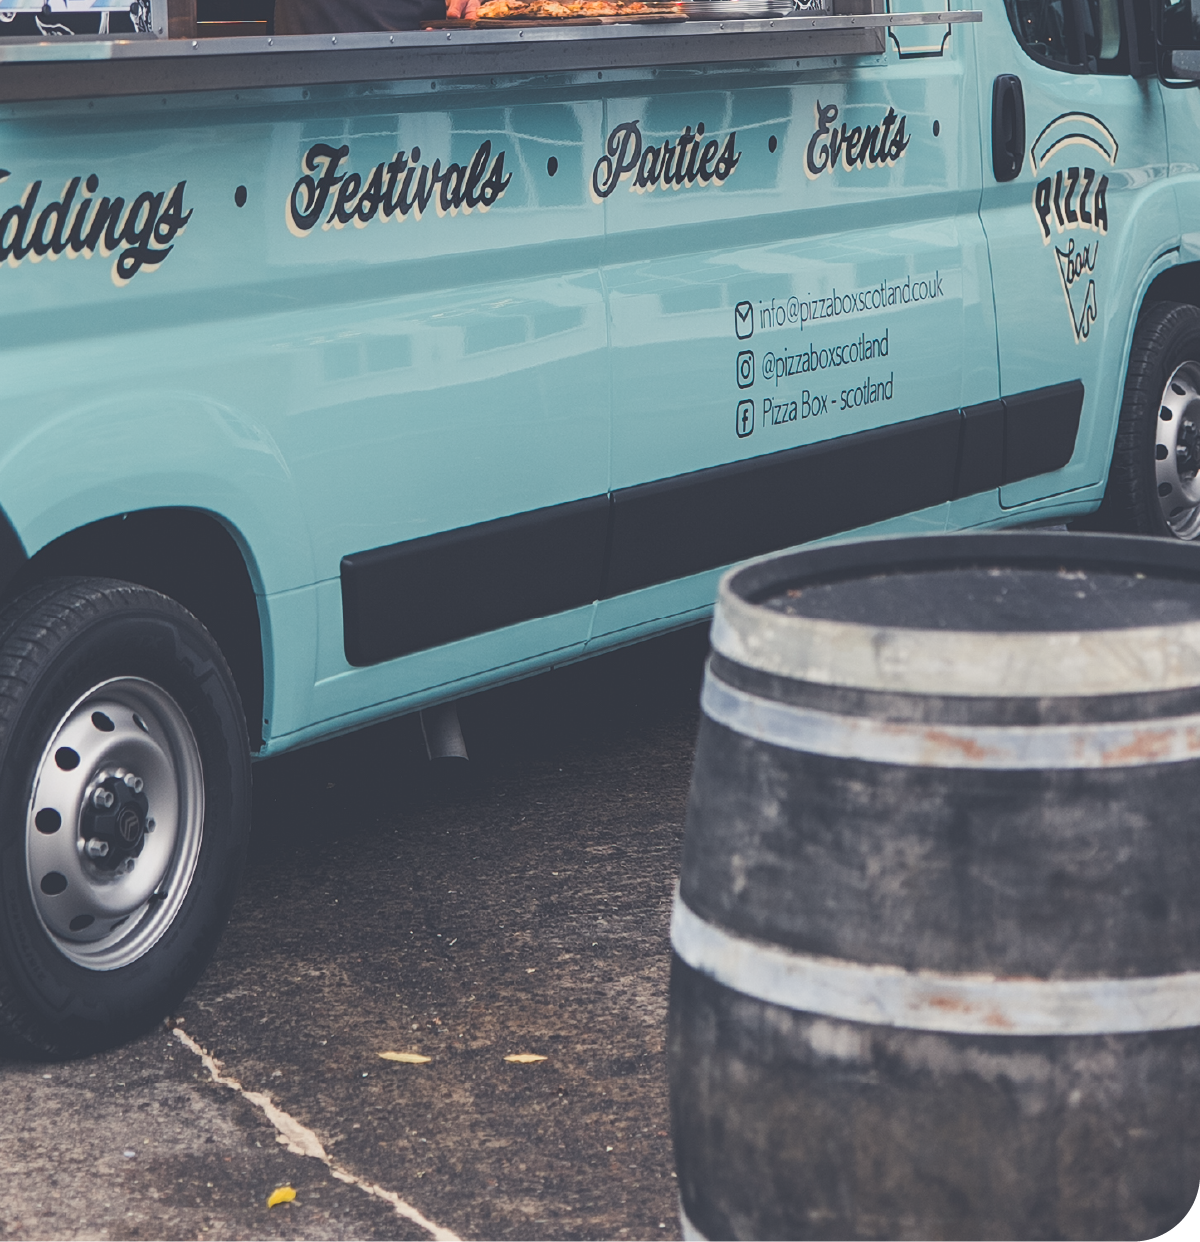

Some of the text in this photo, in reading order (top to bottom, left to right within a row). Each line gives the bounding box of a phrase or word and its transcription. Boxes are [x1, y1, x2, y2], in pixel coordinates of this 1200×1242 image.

[284, 139, 511, 239] Festivals
[589, 119, 742, 205] Parties
[804, 100, 910, 180] Events
[1032, 167, 1109, 246] PIZZA
[758, 270, 944, 331] info@pizzaboxscotland.co.uk
[761, 328, 889, 387] @pizzaboxscotland
[762, 396, 798, 427] Pizza
[801, 389, 828, 419] Box
[840, 371, 894, 410] scotland
